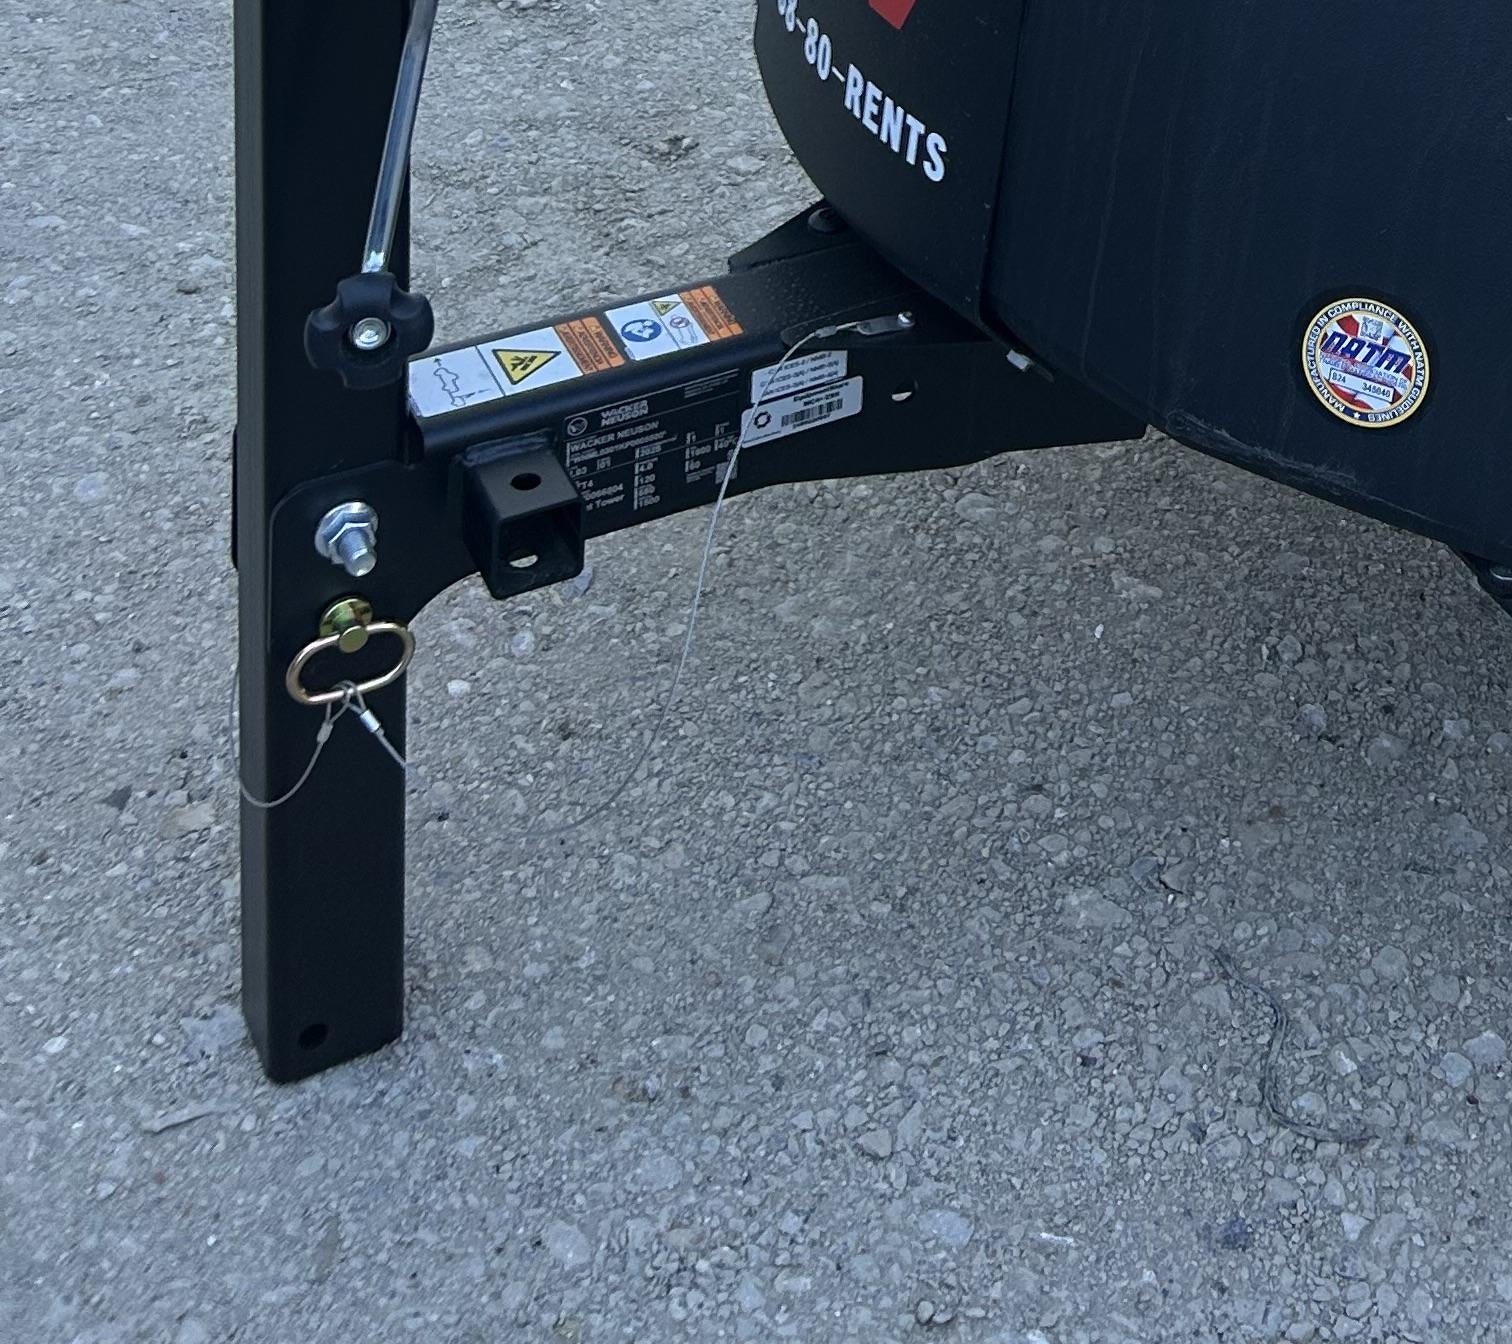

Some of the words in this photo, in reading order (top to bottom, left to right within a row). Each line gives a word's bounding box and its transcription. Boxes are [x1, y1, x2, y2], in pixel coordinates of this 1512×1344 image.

[1318, 315, 1330, 328] IN
[1328, 302, 1397, 322] COMPLIANCE
[1398, 321, 1420, 350] WITH
[1307, 326, 1346, 413] MANUFACTURED
[1415, 351, 1425, 388] NATM
[1367, 389, 1420, 422] GUIDELINES
[571, 432, 616, 452] WACKER
[617, 421, 660, 440] NEUSON
